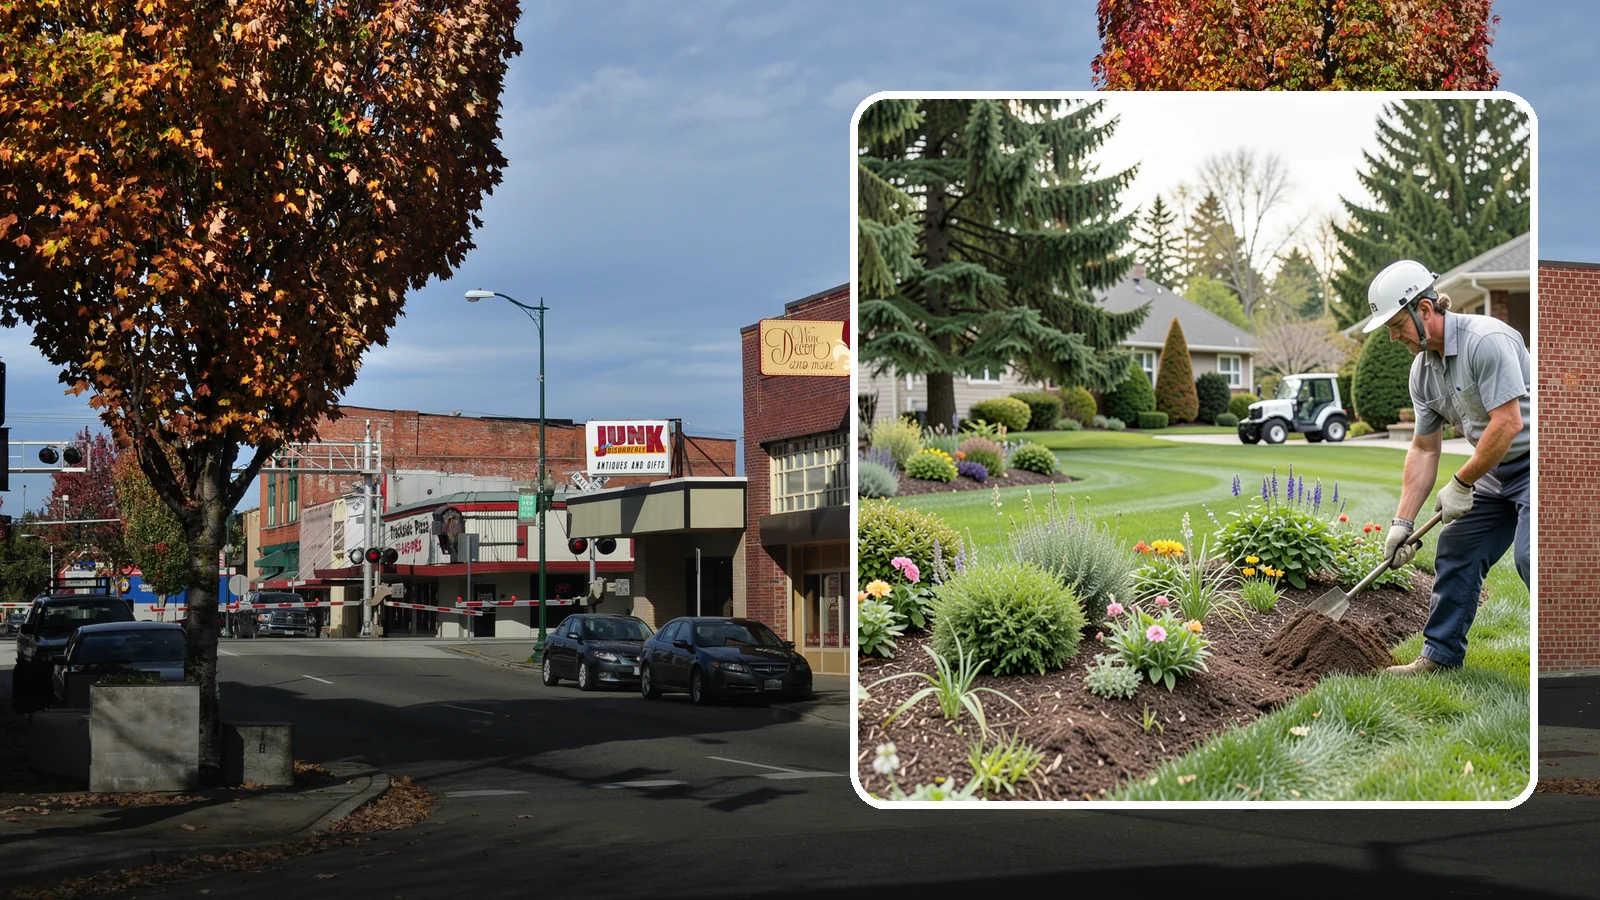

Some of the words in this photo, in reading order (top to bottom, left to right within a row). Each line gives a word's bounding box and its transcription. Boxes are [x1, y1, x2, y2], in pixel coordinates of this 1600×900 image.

[596, 425, 665, 457] JUNK
[607, 446, 646, 454] DISORDERLY
[597, 461, 628, 470] ANTIQUES
[631, 461, 644, 470] AND
[647, 460, 666, 470] GIFTS
[390, 521, 413, 540] Trackside
[414, 519, 429, 535] Pizza
